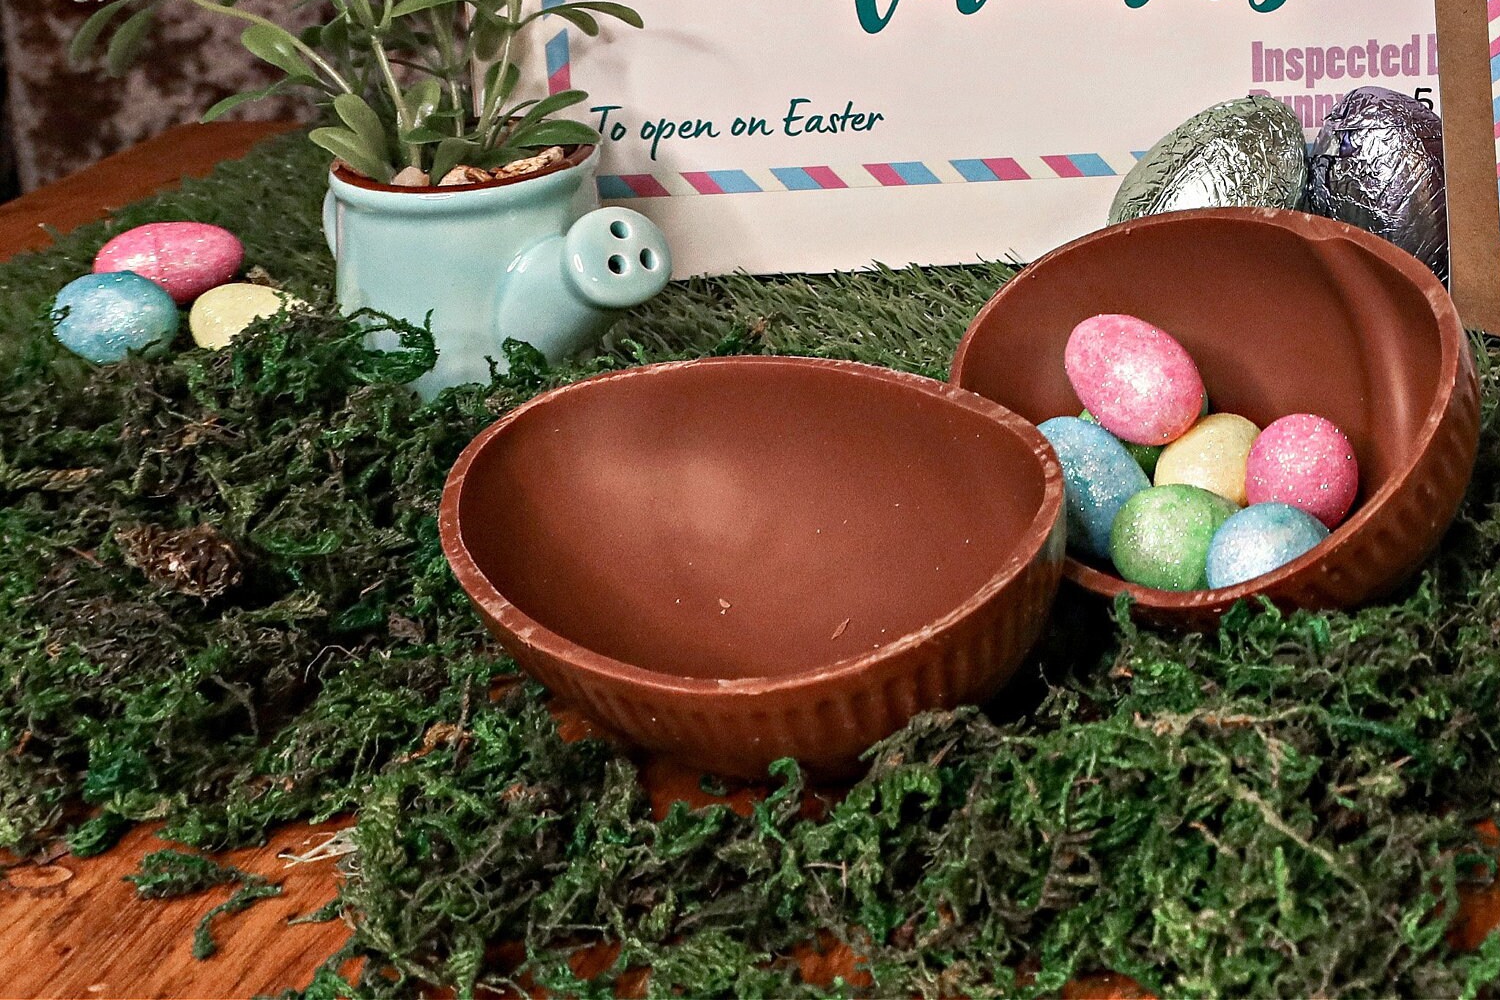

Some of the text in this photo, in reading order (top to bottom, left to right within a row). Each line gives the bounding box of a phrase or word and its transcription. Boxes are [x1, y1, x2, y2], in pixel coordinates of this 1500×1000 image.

[1251, 33, 1420, 89] Inspected
[1414, 86, 1434, 112] 5
[590, 98, 885, 161] To open on Easter
